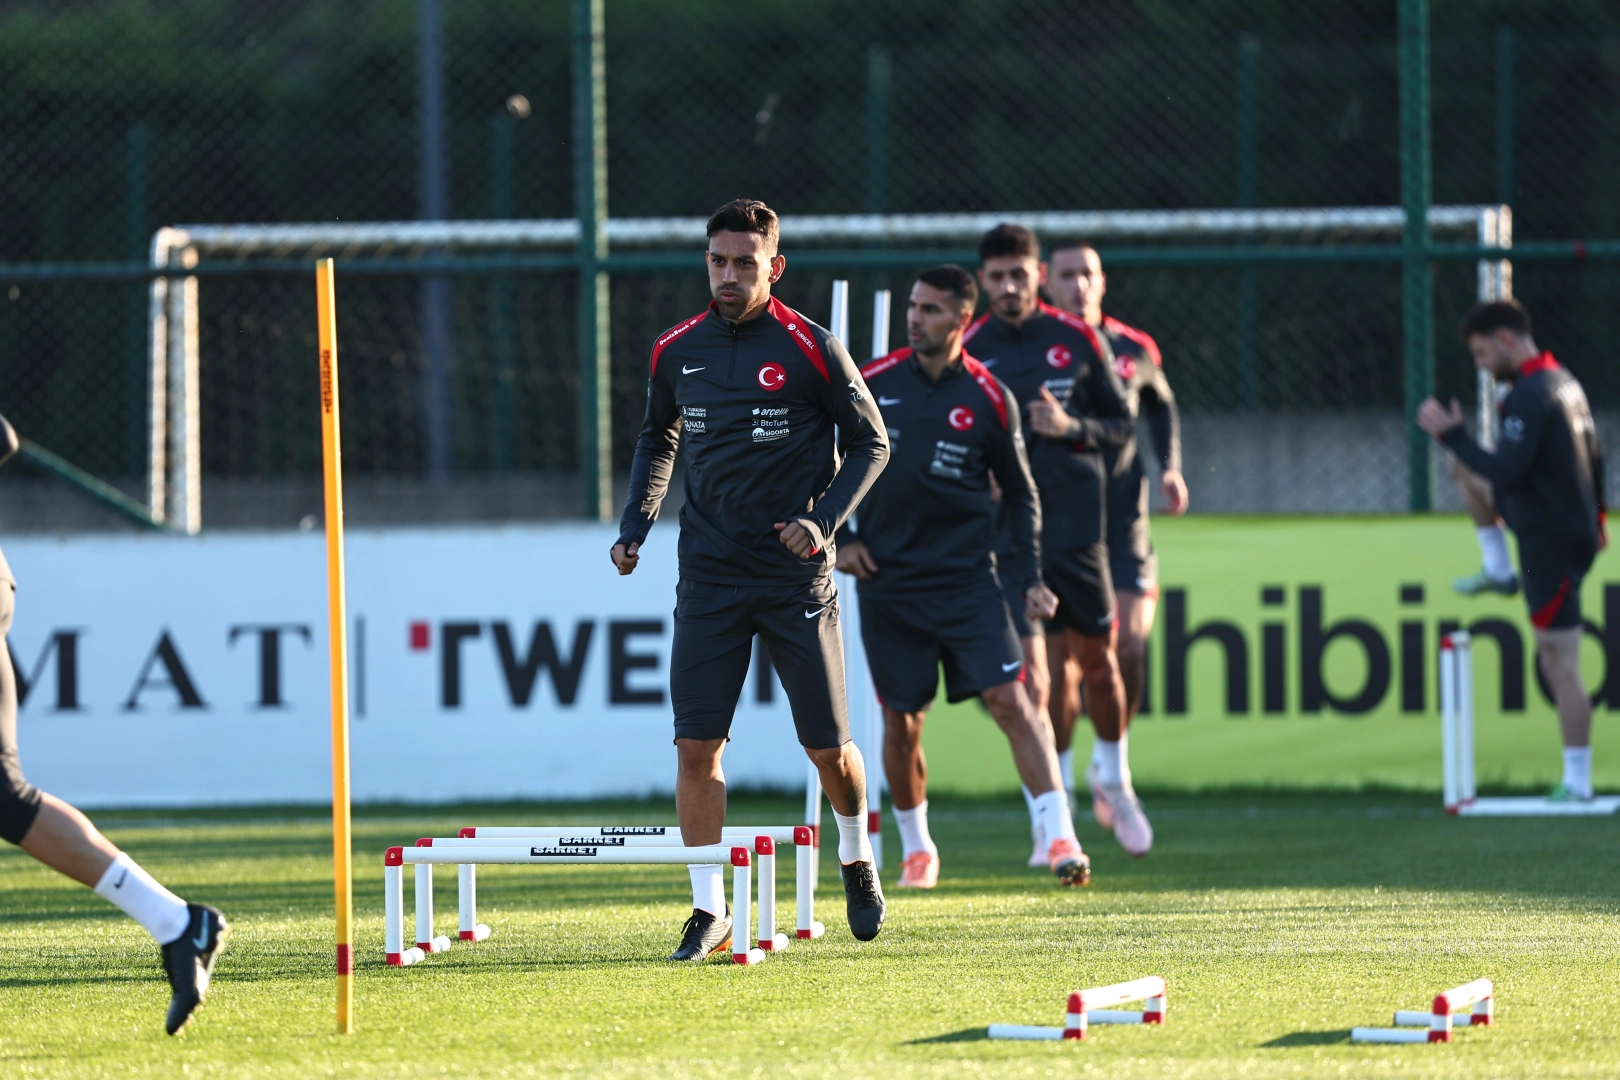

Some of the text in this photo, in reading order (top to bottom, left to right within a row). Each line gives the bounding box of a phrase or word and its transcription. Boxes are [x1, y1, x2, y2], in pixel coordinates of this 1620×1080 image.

[795, 329, 815, 350] TURKCELL
[689, 421, 706, 429] NATA
[760, 419, 789, 427] BtcTurk
[408, 620, 776, 707] TWE
